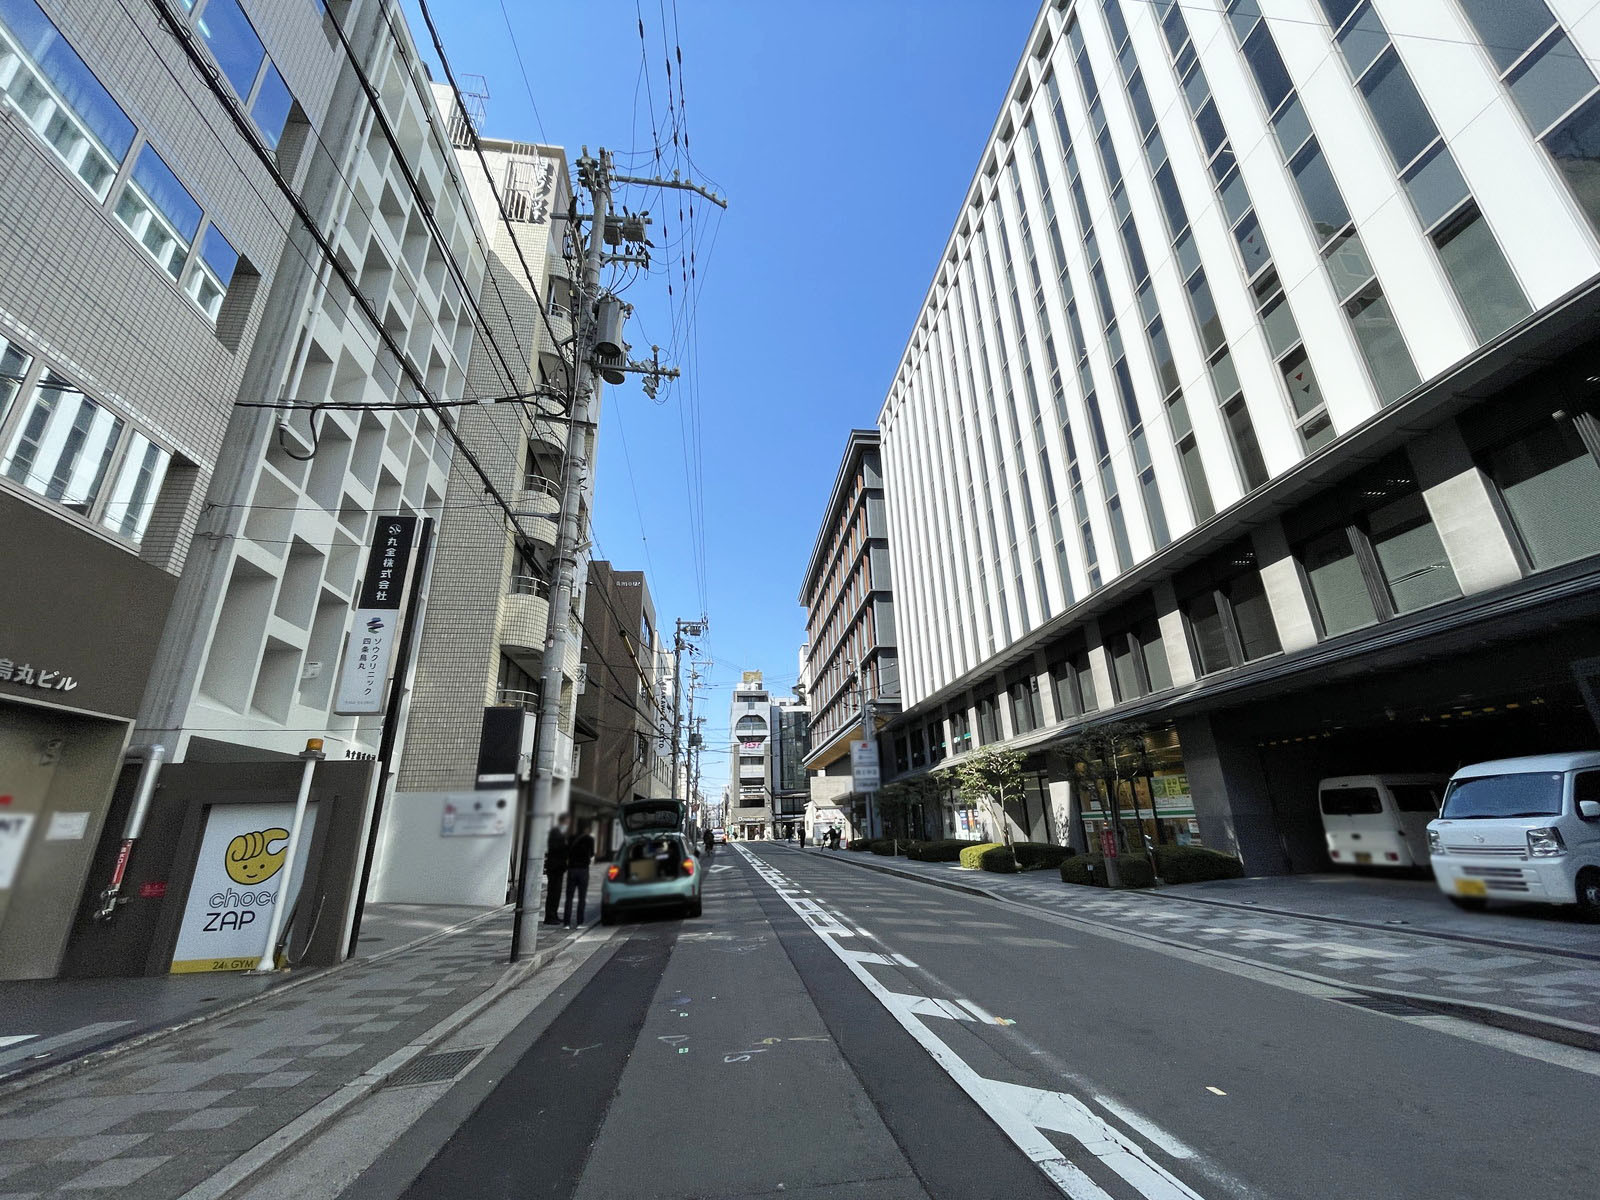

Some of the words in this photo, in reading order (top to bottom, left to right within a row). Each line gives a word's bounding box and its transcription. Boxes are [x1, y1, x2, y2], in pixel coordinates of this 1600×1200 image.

[364, 638, 382, 696] ソウクリニック
[203, 911, 255, 932] ZAP
[231, 960, 254, 969] GYM
